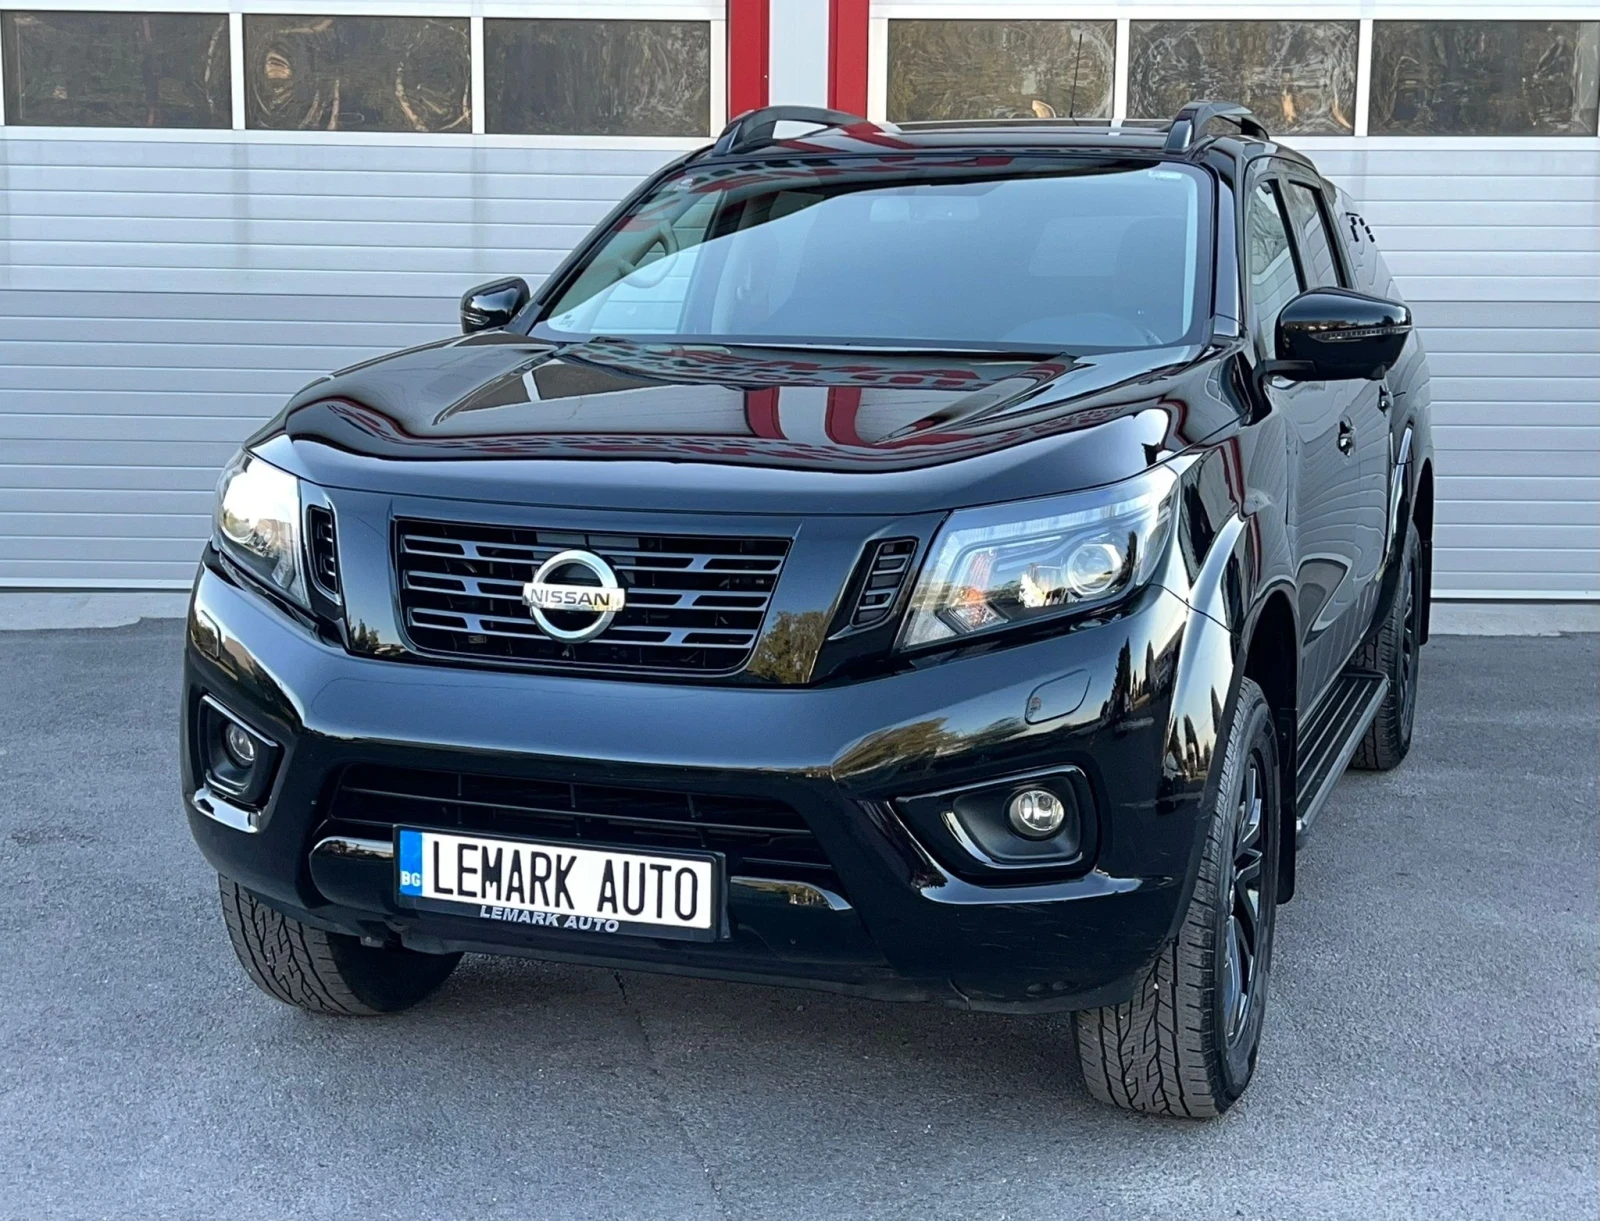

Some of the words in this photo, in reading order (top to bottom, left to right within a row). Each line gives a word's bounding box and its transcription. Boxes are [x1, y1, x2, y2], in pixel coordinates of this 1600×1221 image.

[530, 588, 610, 606] NISSAN
[401, 871, 421, 888] BG
[433, 840, 577, 910] LEMARK
[597, 859, 698, 921] AUTO
[480, 905, 558, 928] LEMARK
[564, 914, 620, 934] AUTO
